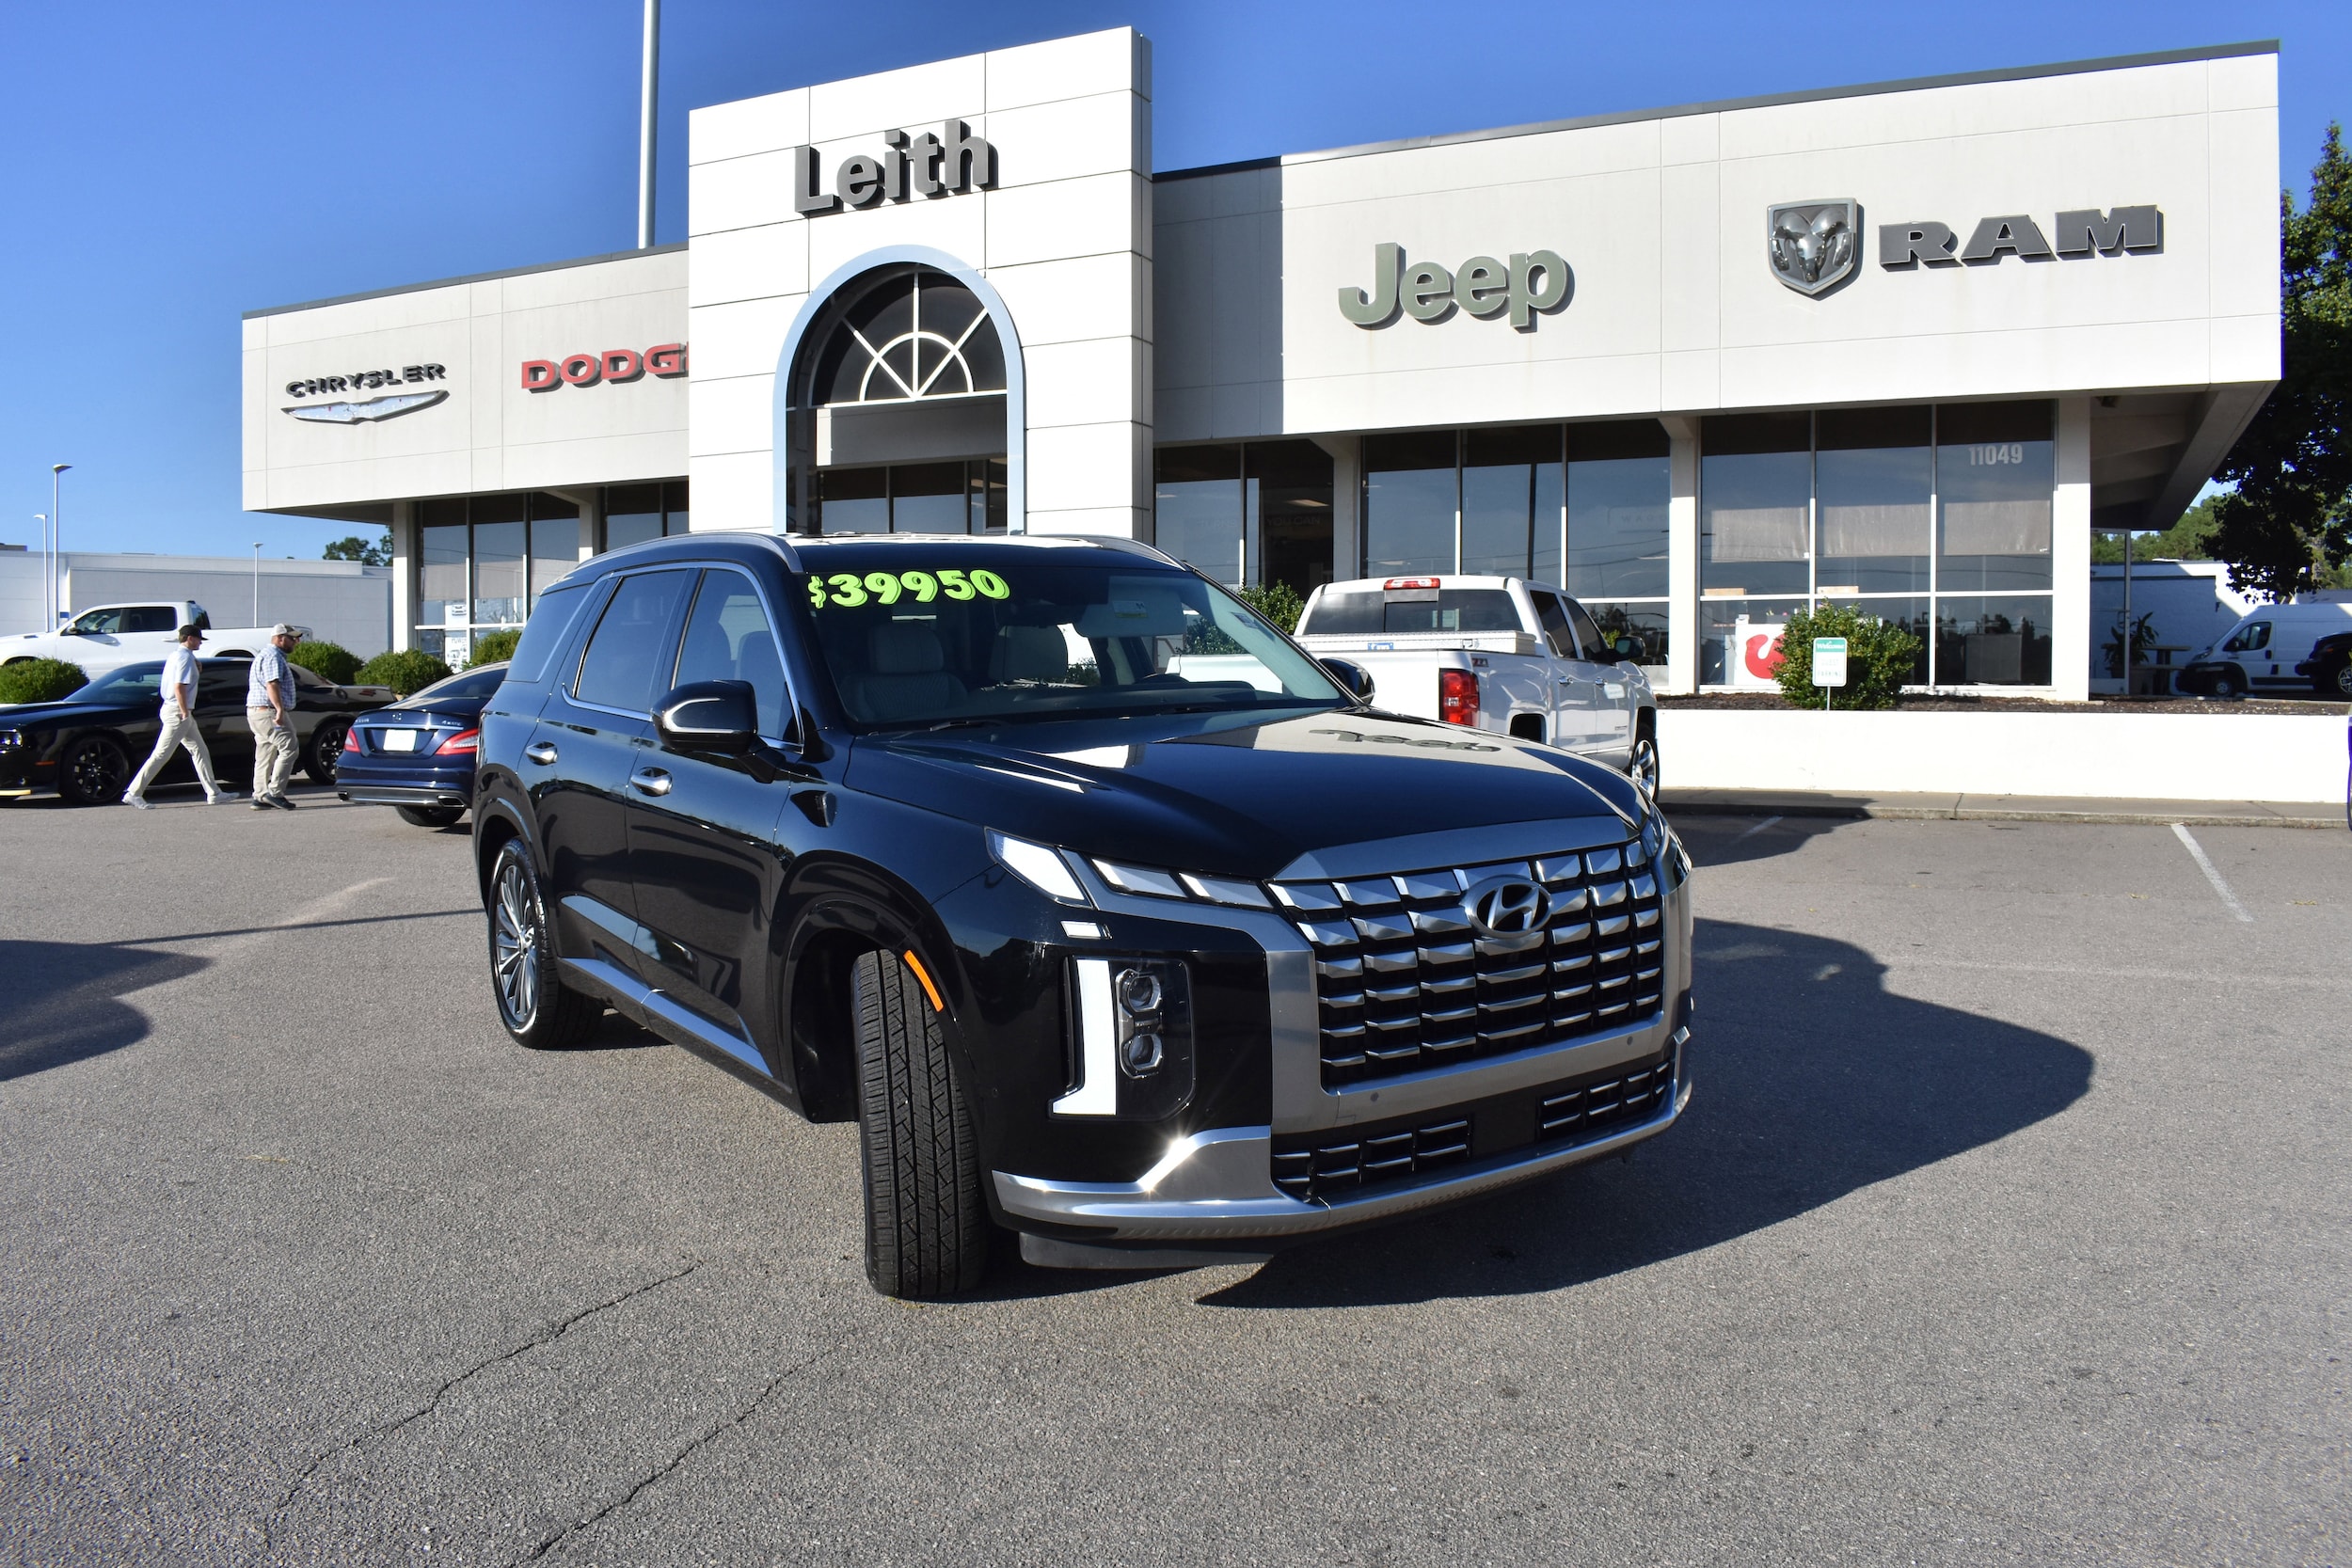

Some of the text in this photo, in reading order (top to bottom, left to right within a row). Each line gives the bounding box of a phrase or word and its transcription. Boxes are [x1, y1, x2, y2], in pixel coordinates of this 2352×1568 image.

[794, 119, 999, 217] Leith
[1878, 204, 2164, 272] RAM
[1338, 242, 1575, 333] Jeep
[285, 362, 447, 398] CHRYSLER
[521, 341, 689, 393] DODG
[1968, 443, 2024, 467] 11049
[807, 568, 1010, 610] $39950
